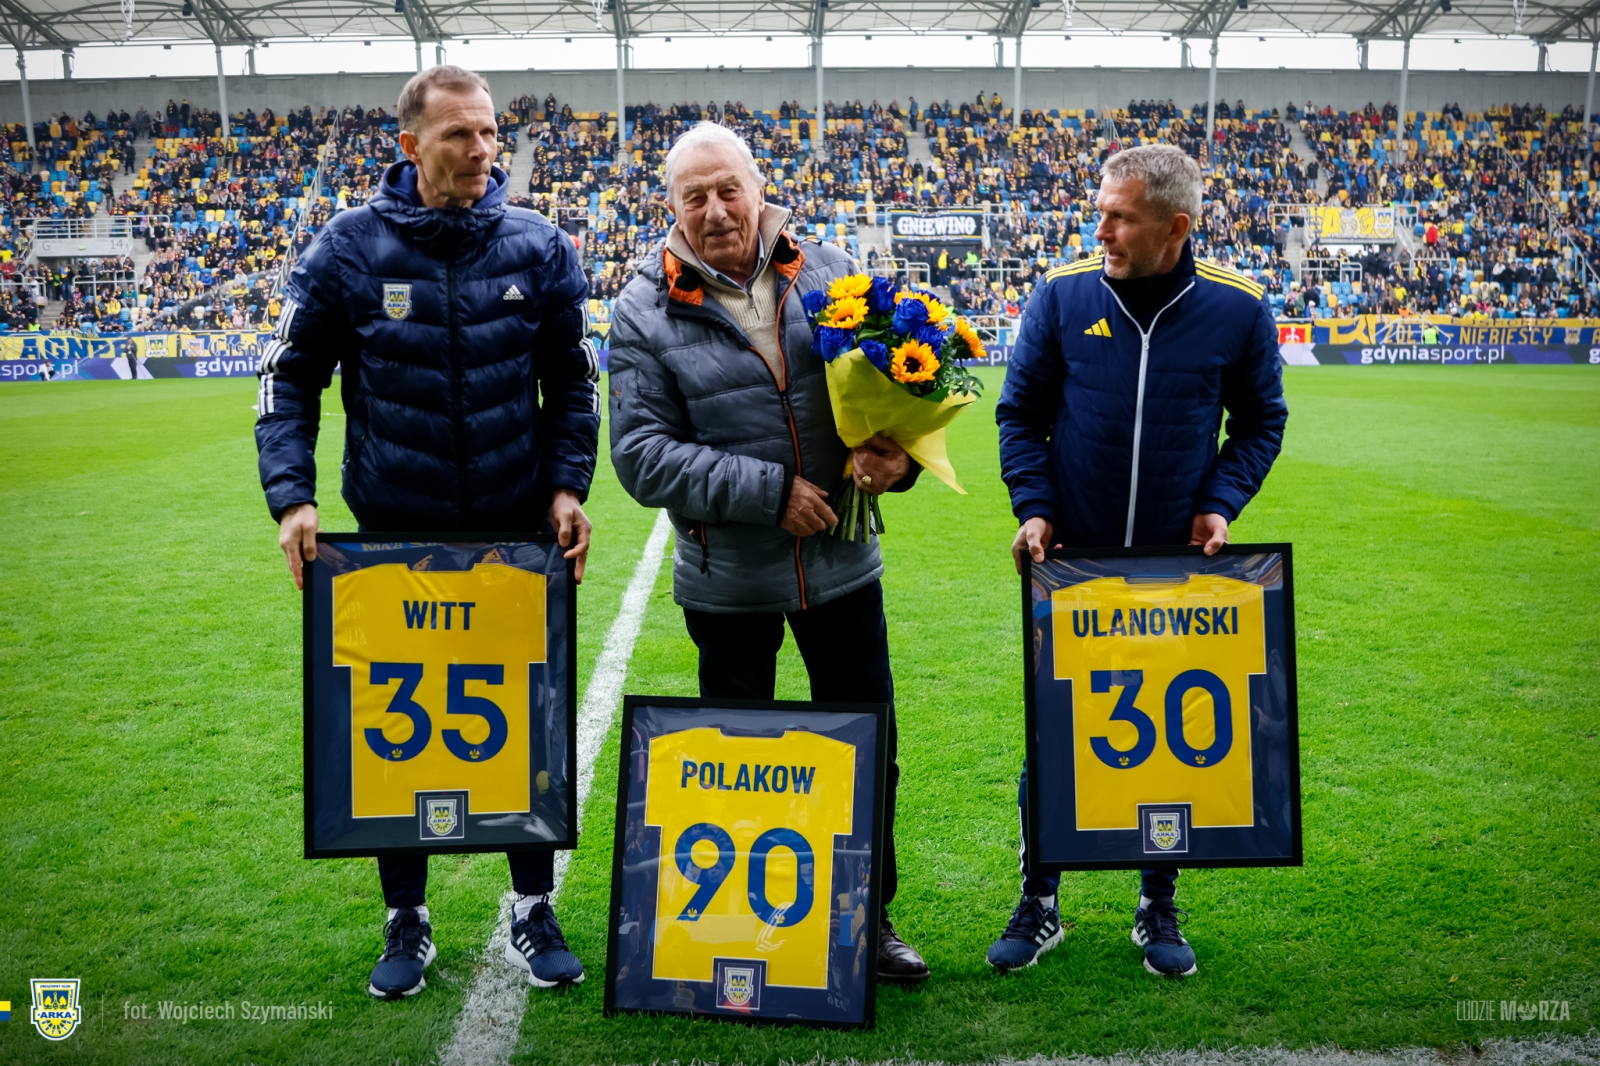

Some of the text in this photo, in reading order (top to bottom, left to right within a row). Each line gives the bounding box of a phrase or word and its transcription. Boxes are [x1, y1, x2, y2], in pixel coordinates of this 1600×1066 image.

[896, 216, 977, 235] GNIEWINO
[42, 240, 51, 251] G
[110, 239, 123, 250] 14
[1460, 327, 1553, 345] NIEBIESCY
[1361, 345, 1505, 364] gdyniasport.pl
[403, 600, 476, 630] WITT
[1073, 606, 1239, 638] ULANOWSKI
[364, 662, 508, 763] 35
[1090, 669, 1233, 769] 30
[681, 761, 816, 794] POLAKOW
[675, 823, 815, 928] 90
